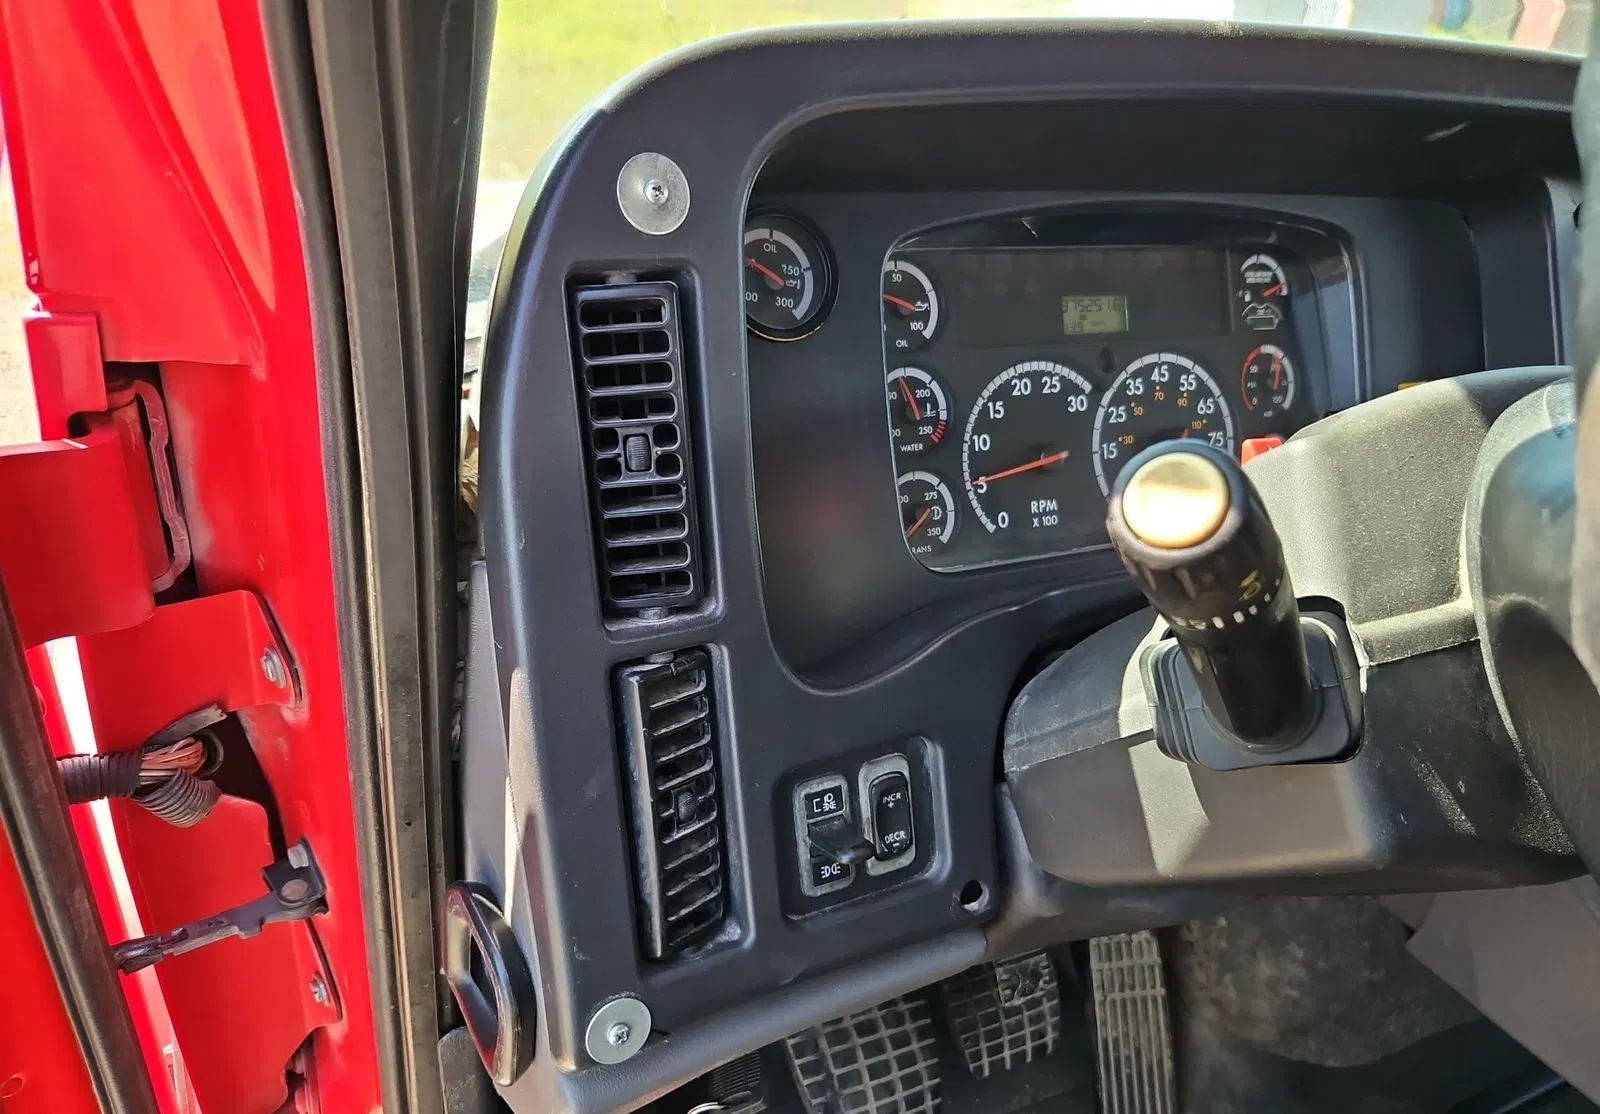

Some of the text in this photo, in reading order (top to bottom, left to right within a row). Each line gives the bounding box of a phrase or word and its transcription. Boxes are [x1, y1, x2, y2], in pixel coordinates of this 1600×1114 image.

[763, 243, 778, 253] OIL
[892, 273, 902, 283] 50
[745, 291, 759, 303] 00
[775, 296, 794, 308] 300
[909, 321, 924, 331] 100
[896, 339, 908, 348] OIL
[1150, 364, 1170, 383] 45
[1011, 377, 1032, 396] 20
[1041, 375, 1062, 394] 25
[1125, 378, 1145, 396] 35
[1179, 374, 1198, 392] 55
[888, 391, 898, 401] 50
[915, 389, 931, 399] 200
[1154, 392, 1165, 401] 70
[1067, 395, 1089, 413] 30
[1177, 398, 1188, 407] 90
[1197, 397, 1216, 415] 65
[987, 401, 1006, 419] 15
[1108, 405, 1128, 424] 25
[1133, 406, 1144, 416] 50
[919, 425, 934, 435] 250
[1191, 419, 1203, 430] 110
[972, 433, 992, 452] 10
[1123, 434, 1134, 445] 30
[1207, 431, 1225, 447] 75
[900, 443, 924, 452] WATER
[1101, 442, 1118, 460] 15
[976, 476, 988, 494] 5
[924, 491, 938, 501] 275
[1030, 499, 1058, 514] RPM
[997, 511, 1010, 528] 0
[1032, 515, 1058, 528] X 100
[927, 527, 941, 537] 350
[911, 544, 932, 554] RANS
[882, 791, 902, 804] INCR
[884, 830, 906, 844] DECR
